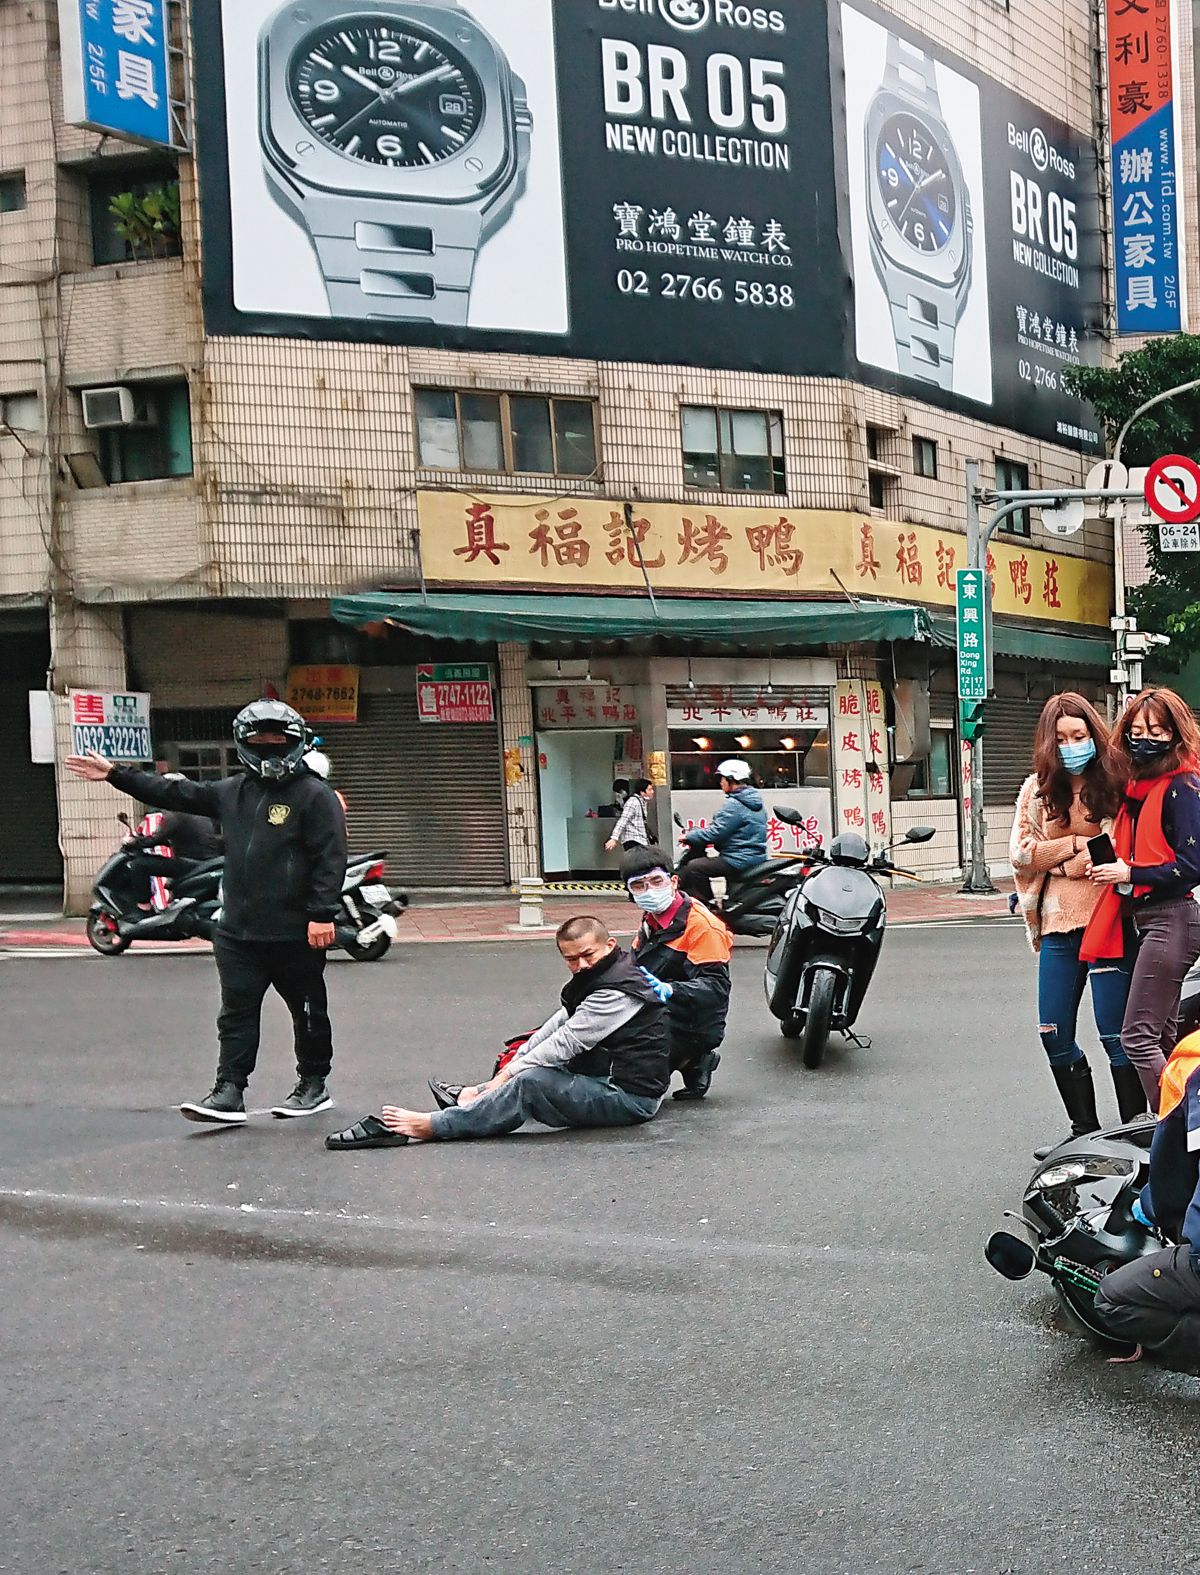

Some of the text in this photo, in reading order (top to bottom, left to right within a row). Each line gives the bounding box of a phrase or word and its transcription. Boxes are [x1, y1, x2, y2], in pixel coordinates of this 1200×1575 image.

[714, 0, 785, 31] Ross
[87, 41, 106, 95] 2/5F
[368, 38, 402, 62] 12
[313, 79, 339, 100] 9
[601, 37, 787, 133] BR 05
[376, 134, 402, 156] 6
[605, 122, 790, 170] NEW COLLECTION
[1007, 122, 1028, 154] Bell
[1049, 145, 1075, 180] Ross
[887, 168, 899, 187] 9
[612, 201, 791, 252] 寶鴻堂鐘表
[914, 222, 925, 241] 6
[1010, 169, 1078, 260] BR 05
[1120, 147, 1158, 312] 辦公家具
[1159, 128, 1177, 308] www.fid.com.tw 2/5F
[615, 238, 644, 251] PRO
[646, 241, 719, 260] HOPETIME
[720, 248, 769, 265] WATCH
[1012, 238, 1079, 289] NEW COLLECTION
[616, 269, 794, 307] 02 2766 5838
[1015, 304, 1080, 353] 寶鴻堂鐘表
[1018, 359, 1031, 381] 02
[1034, 365, 1057, 390] 2766
[452, 502, 804, 577] 真福記烤鴨
[1161, 526, 1197, 536] 06-24
[1162, 537, 1198, 549] 公車除外
[962, 583, 979, 648] 東興路
[960, 651, 980, 659] Dong
[960, 660, 977, 668] Xing
[438, 684, 489, 706] 2747-1122
[76, 726, 149, 757] 0932-322218
[839, 694, 865, 828] 脆皮烤鴨
[866, 689, 887, 835] 脆皮烤鴨
